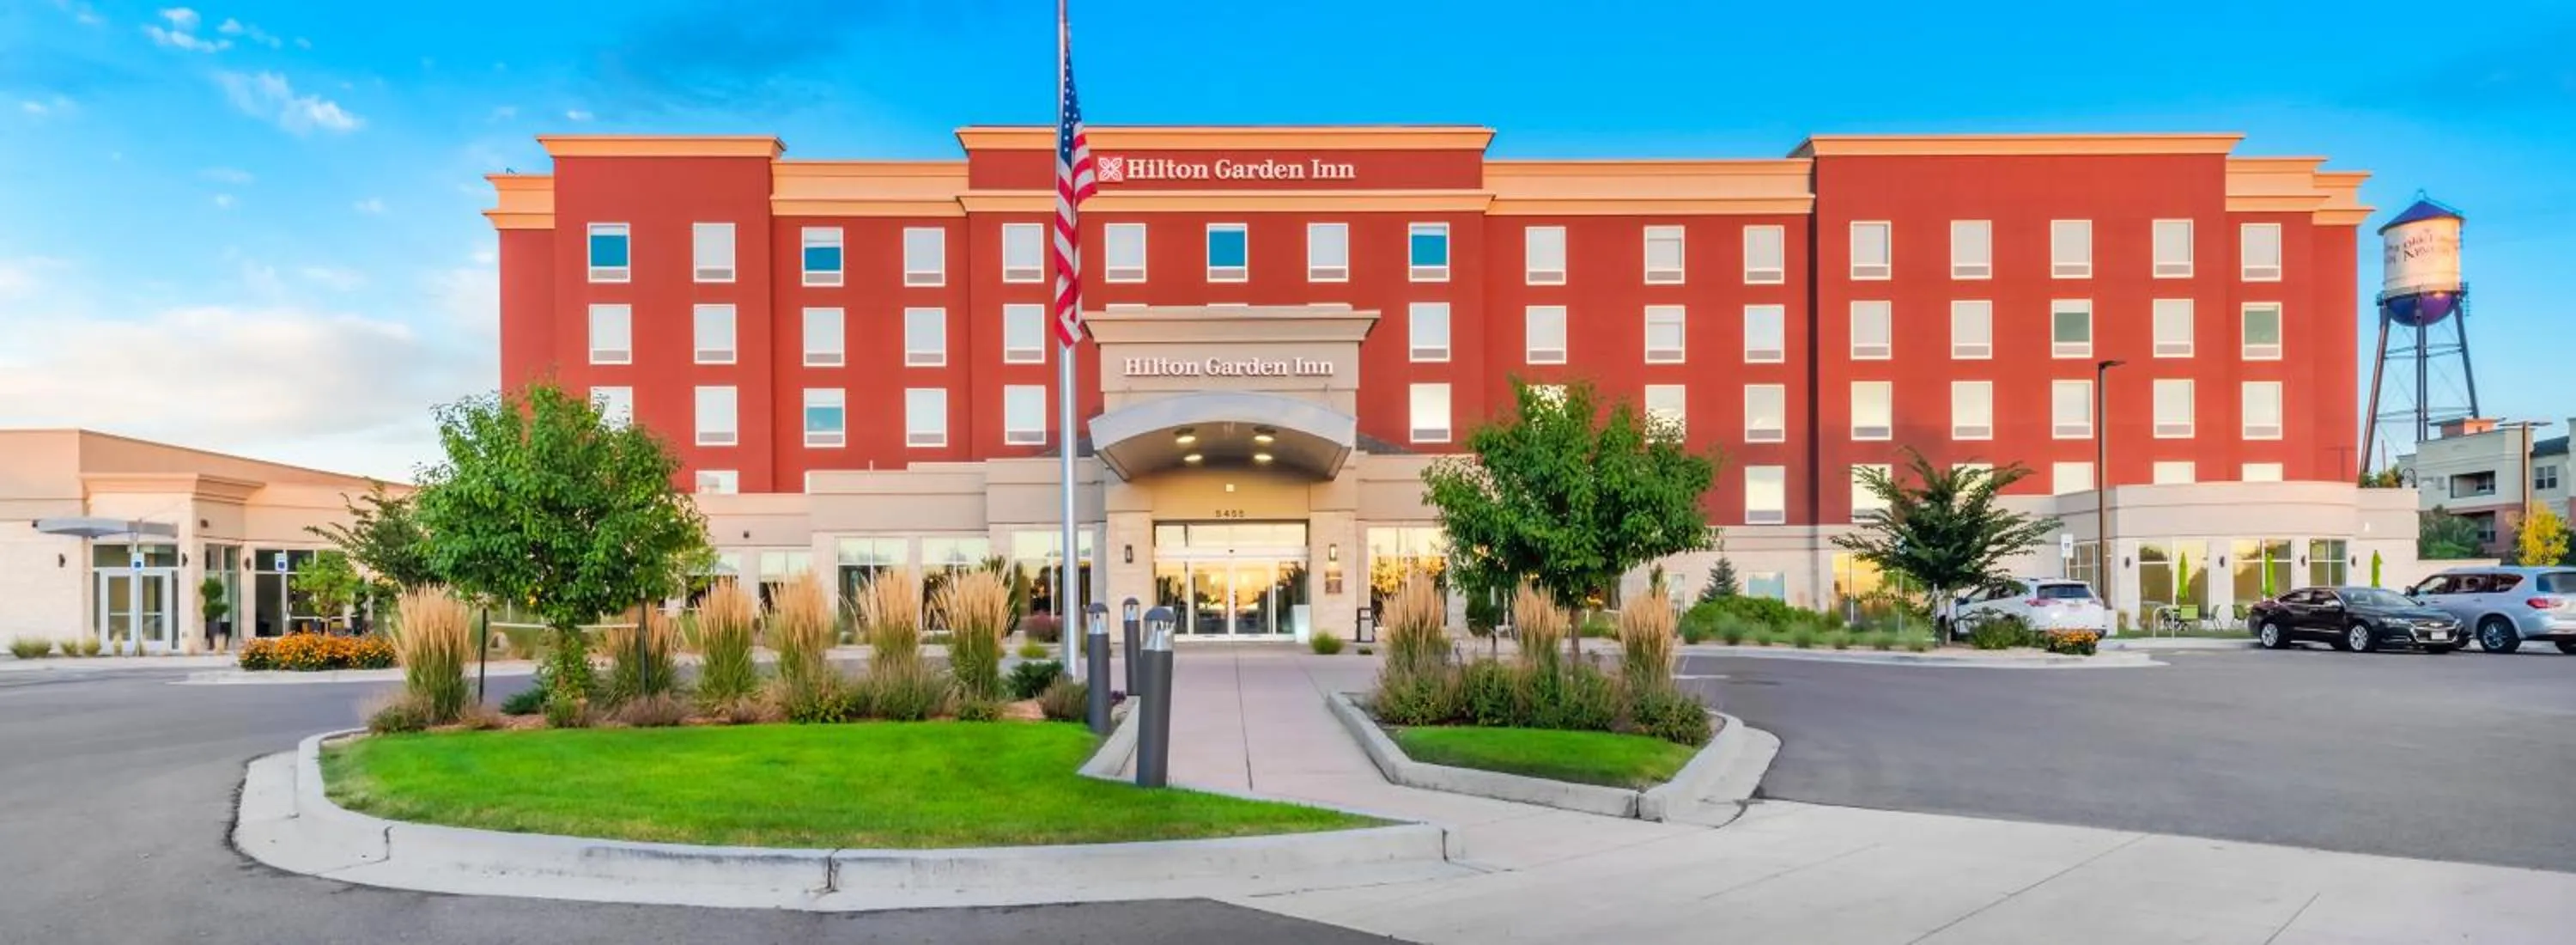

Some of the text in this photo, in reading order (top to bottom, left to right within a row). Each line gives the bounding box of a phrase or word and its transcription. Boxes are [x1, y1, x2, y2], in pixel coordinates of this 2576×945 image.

[1127, 159, 1356, 180] Hilton Garden Inn
[1124, 357, 1334, 375] Hilton Garden Inn
